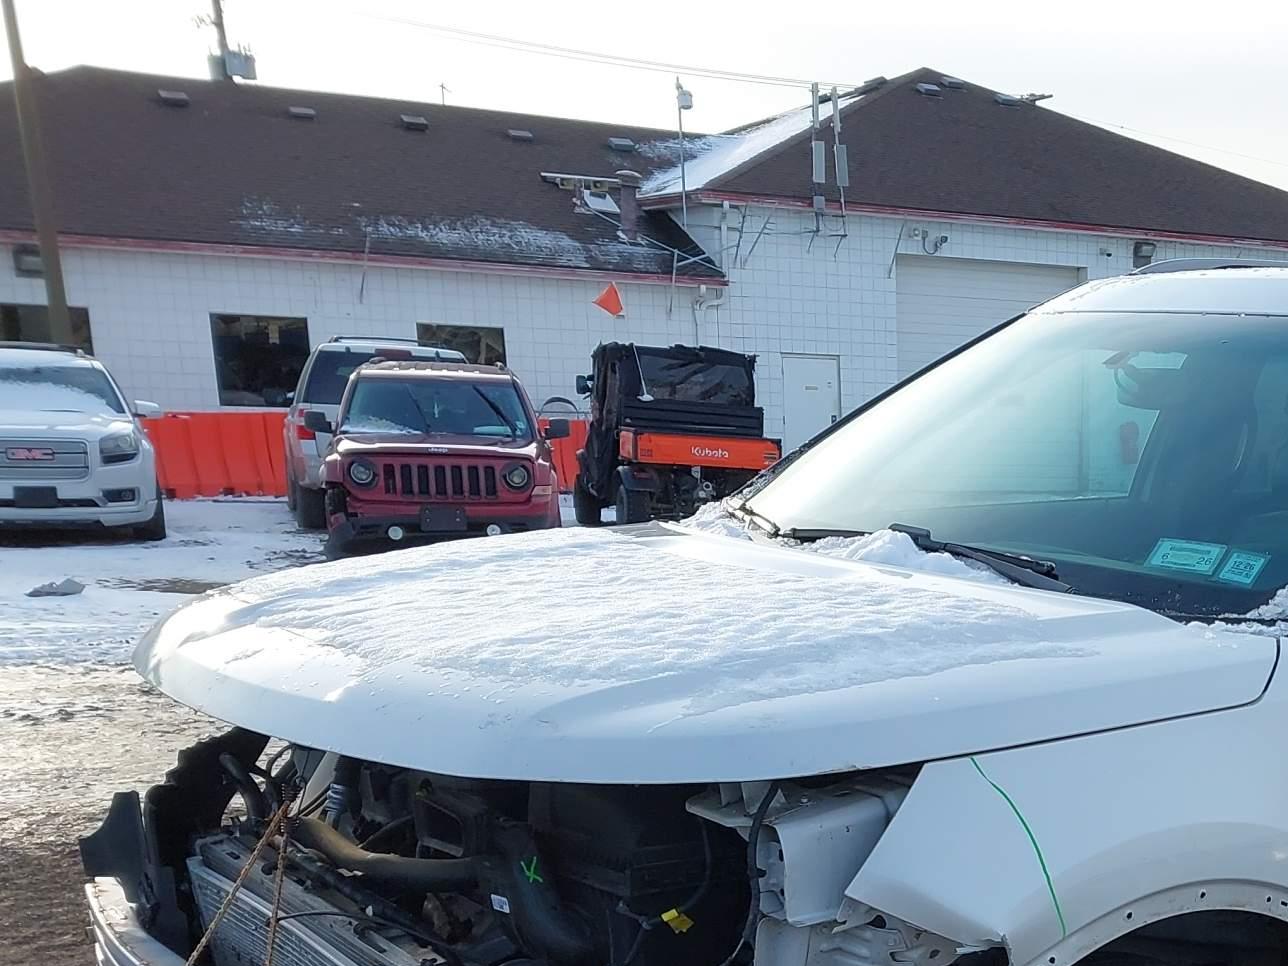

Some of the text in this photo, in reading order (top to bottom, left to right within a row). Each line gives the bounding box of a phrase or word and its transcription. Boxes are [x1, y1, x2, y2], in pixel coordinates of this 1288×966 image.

[6, 448, 55, 460] GMC
[691, 446, 729, 458] Kubota
[1161, 552, 1170, 560] 6
[1196, 556, 1214, 566] 26
